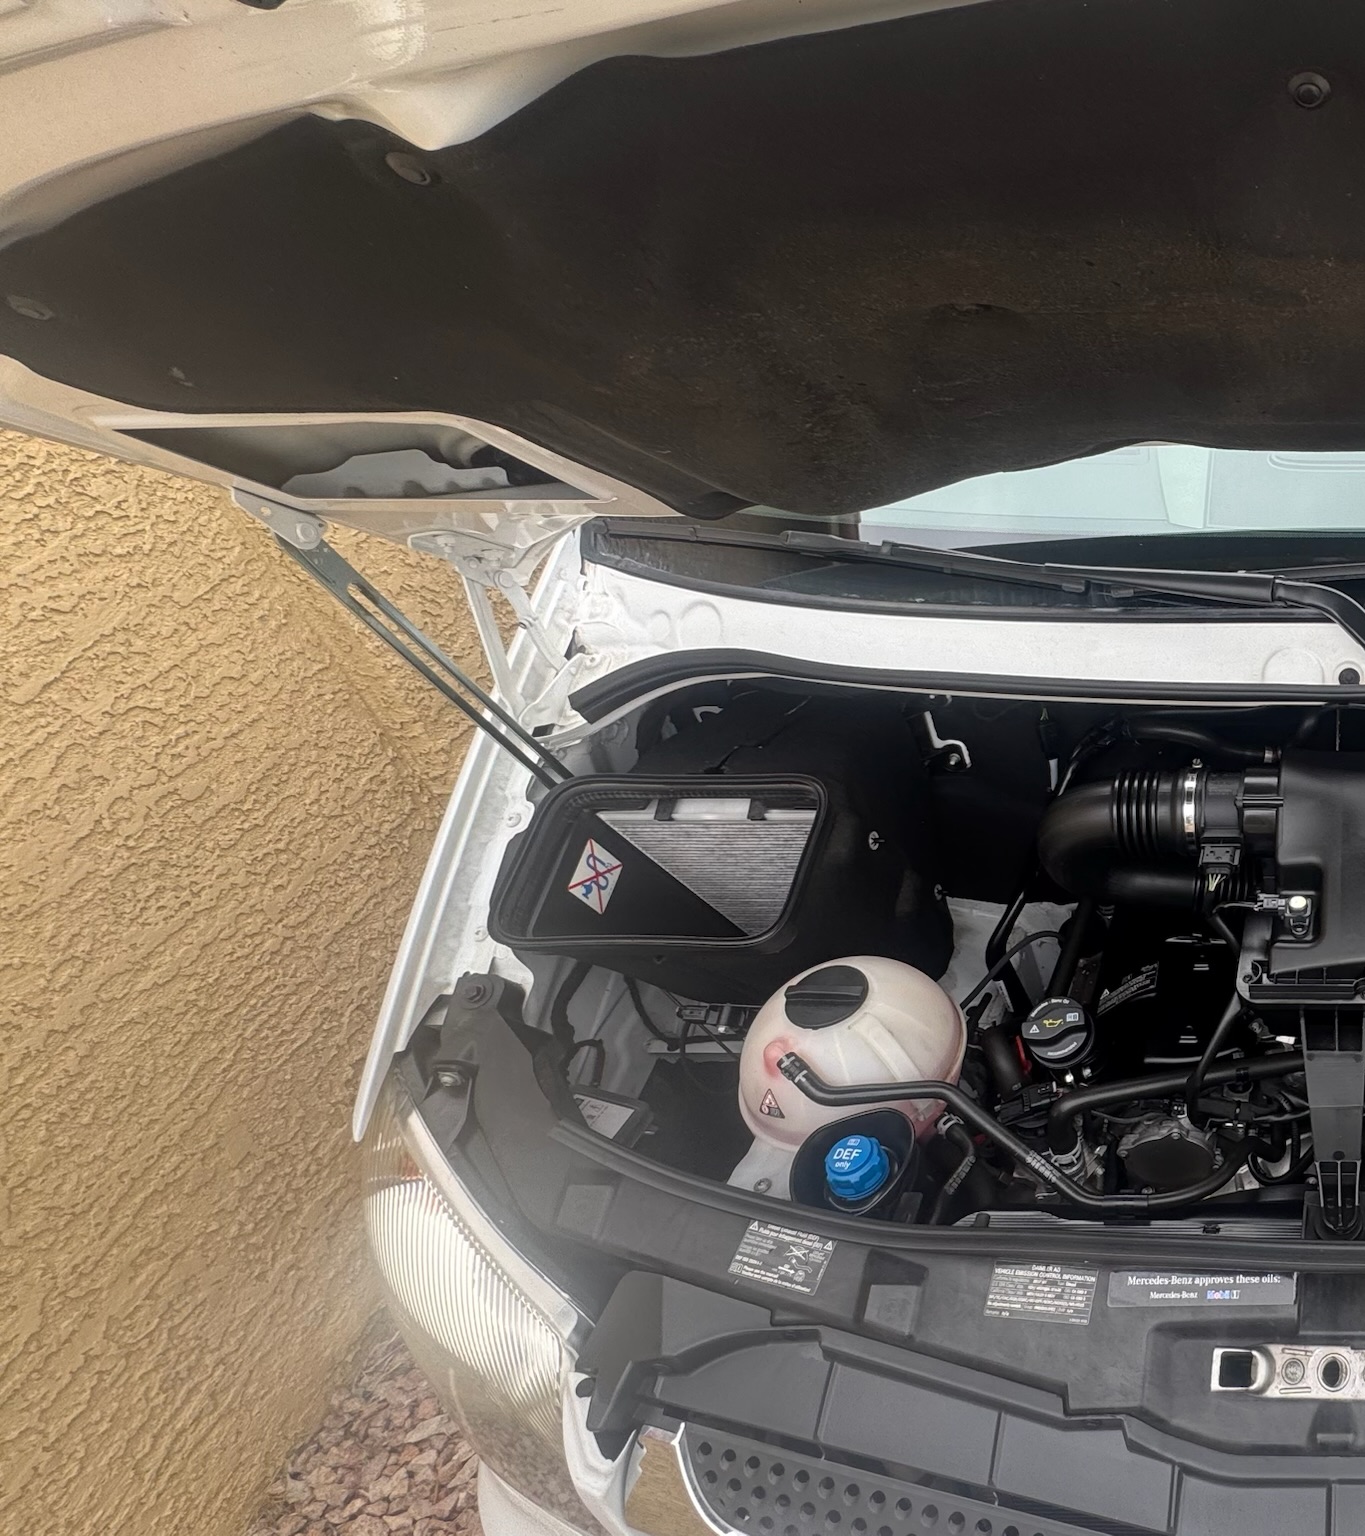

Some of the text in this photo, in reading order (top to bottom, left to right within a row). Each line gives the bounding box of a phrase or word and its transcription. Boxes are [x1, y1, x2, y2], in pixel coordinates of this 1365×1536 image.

[833, 1148, 862, 1160] DEF
[835, 1160, 851, 1170] only
[1014, 1269, 1039, 1277] EMISSION
[1039, 1271, 1062, 1279] CONTROL
[1062, 1273, 1096, 1282] INFORMATION
[1127, 1274, 1281, 1287] Mercedes-Benz approves these oils:
[1150, 1290, 1199, 1300] Mercedes-Benz
